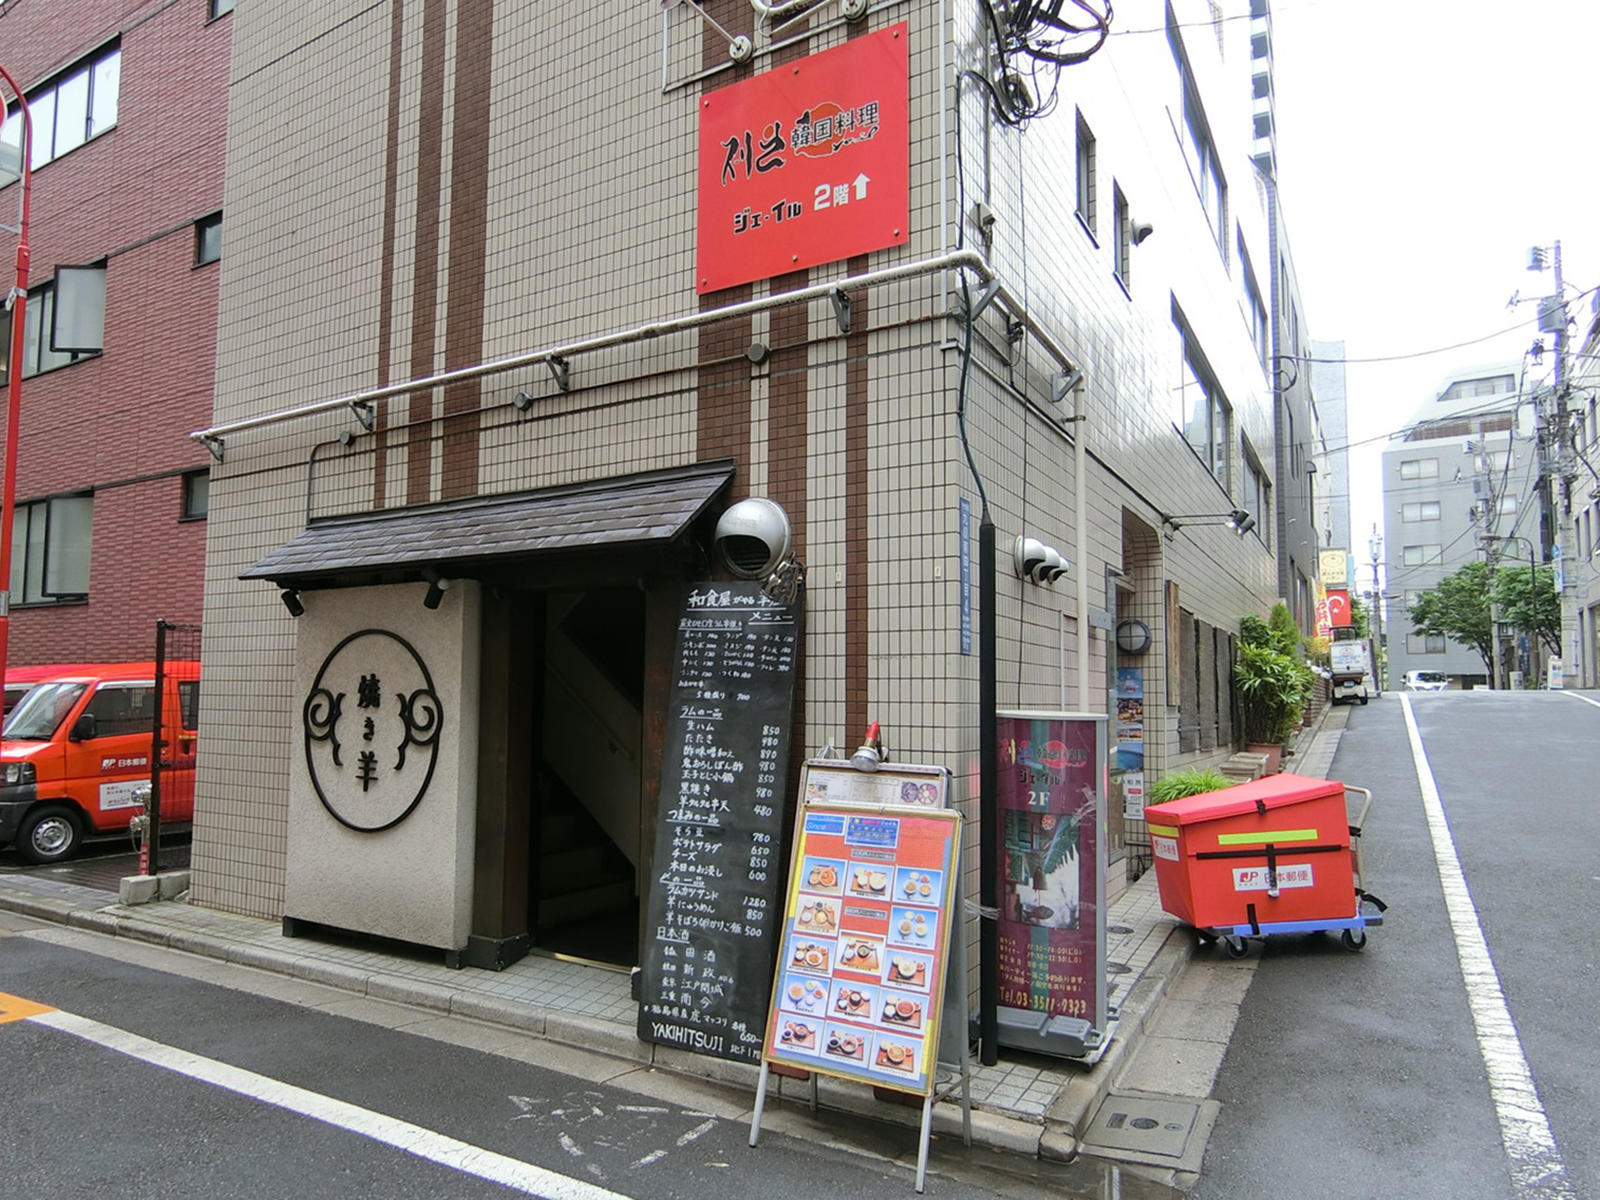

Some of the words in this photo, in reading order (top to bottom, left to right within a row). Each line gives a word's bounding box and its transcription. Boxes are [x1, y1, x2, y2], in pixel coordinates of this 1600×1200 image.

[790, 100, 880, 150] 韓国料理
[813, 182, 850, 212] 2階
[749, 611, 793, 621] メニュー
[696, 690, 726, 700] 5種盛り
[736, 692, 751, 701] 700
[681, 704, 723, 718] ラムの一品
[686, 719, 715, 732] 生ハム
[762, 725, 780, 736] 850
[684, 733, 713, 745] たたき
[761, 736, 779, 748] 980
[683, 744, 735, 759] 酢味噌和え
[759, 749, 778, 760] 890
[118, 757, 148, 768] 日本郵便
[758, 760, 776, 772] 980
[757, 774, 775, 784] 850
[678, 781, 711, 797] 黒焼き
[755, 786, 773, 799] 980
[1027, 790, 1051, 806] 2F
[667, 808, 719, 824] つまみの一品
[753, 804, 773, 817] 480
[674, 825, 705, 838] そら豆
[752, 832, 771, 843] 780
[672, 836, 723, 854] ポテトサラダ
[750, 845, 770, 856] 650
[671, 847, 698, 861] チーズ
[749, 856, 768, 868] 850
[668, 859, 723, 878] 本日のお浸し
[748, 869, 767, 881] 600
[667, 883, 720, 901] ラムカツサンド
[742, 895, 767, 908] 1280
[666, 895, 716, 914] 羊にゅうめん
[745, 908, 764, 921] 850
[656, 926, 690, 941] 日本酒
[744, 925, 763, 938] 500
[683, 963, 716, 979] 新政
[660, 990, 677, 1001] 三重
[680, 978, 724, 997] 江戸開城
[651, 1021, 724, 1052] YAKIHITSUJI
